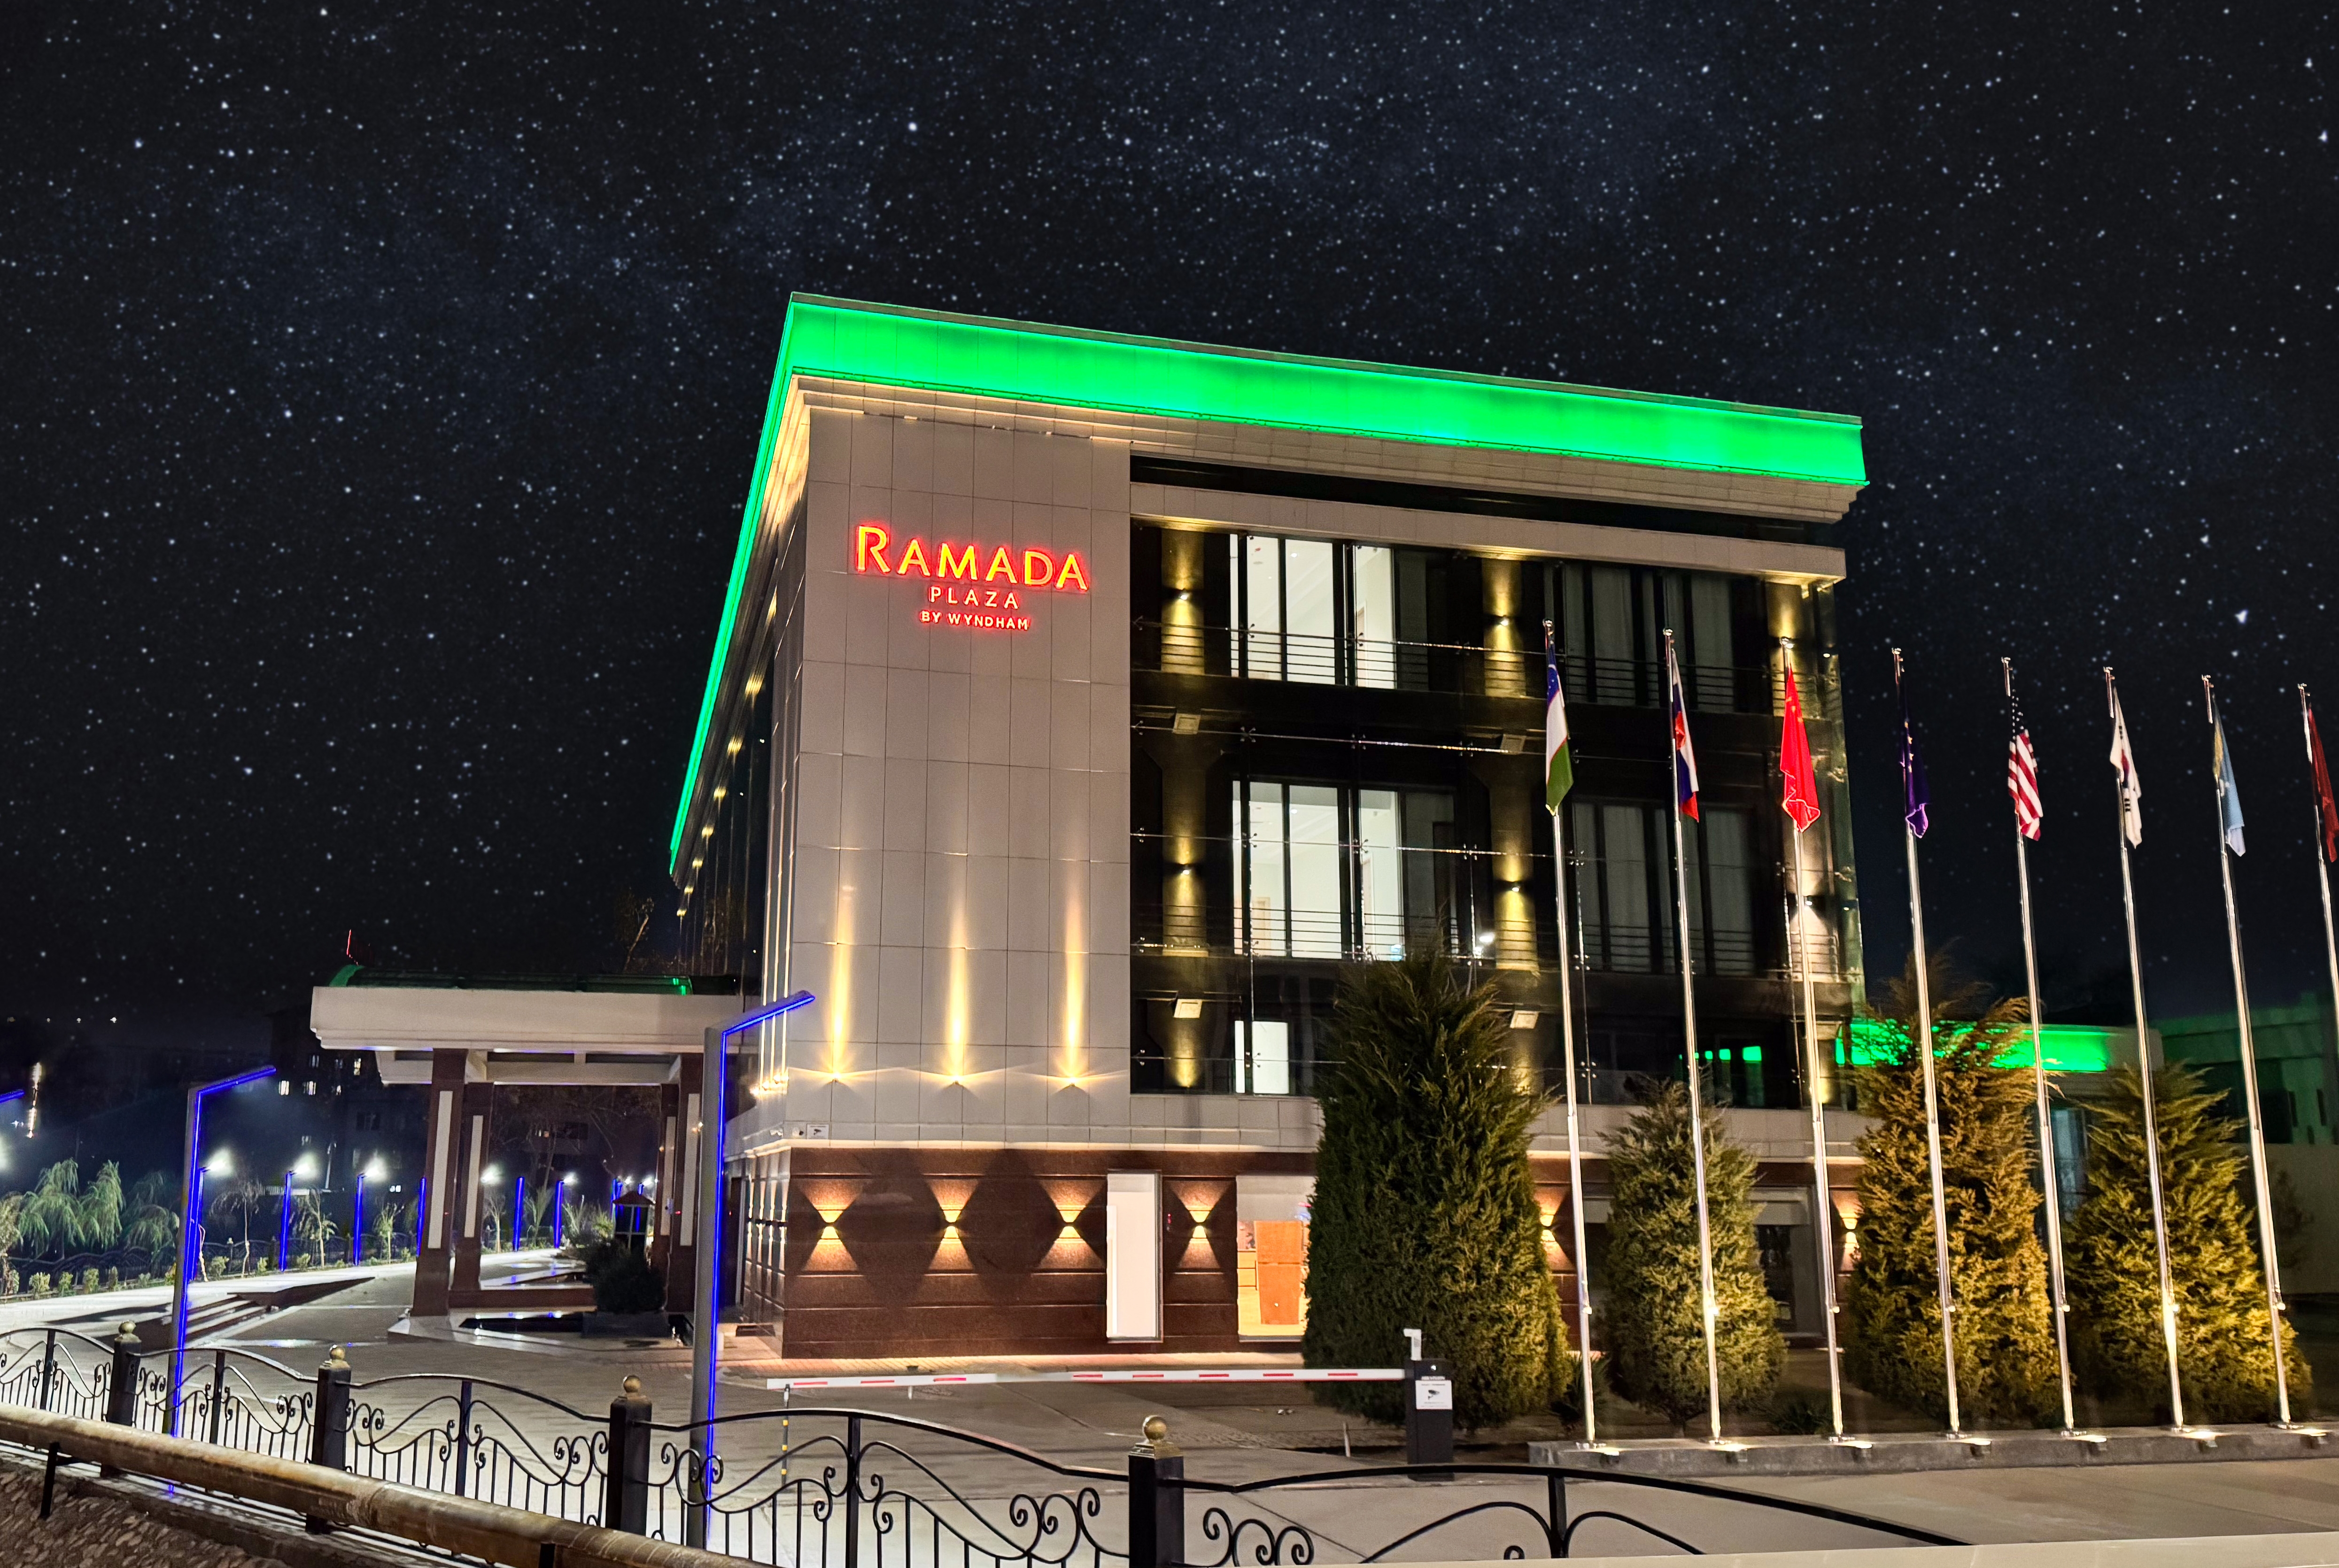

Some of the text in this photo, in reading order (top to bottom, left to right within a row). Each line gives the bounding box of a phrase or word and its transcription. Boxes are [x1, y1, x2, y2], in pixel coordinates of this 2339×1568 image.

[857, 525, 1089, 590] RAMADA
[929, 586, 1019, 609] PLAZA
[921, 610, 1029, 630] BY WYNDHAM
